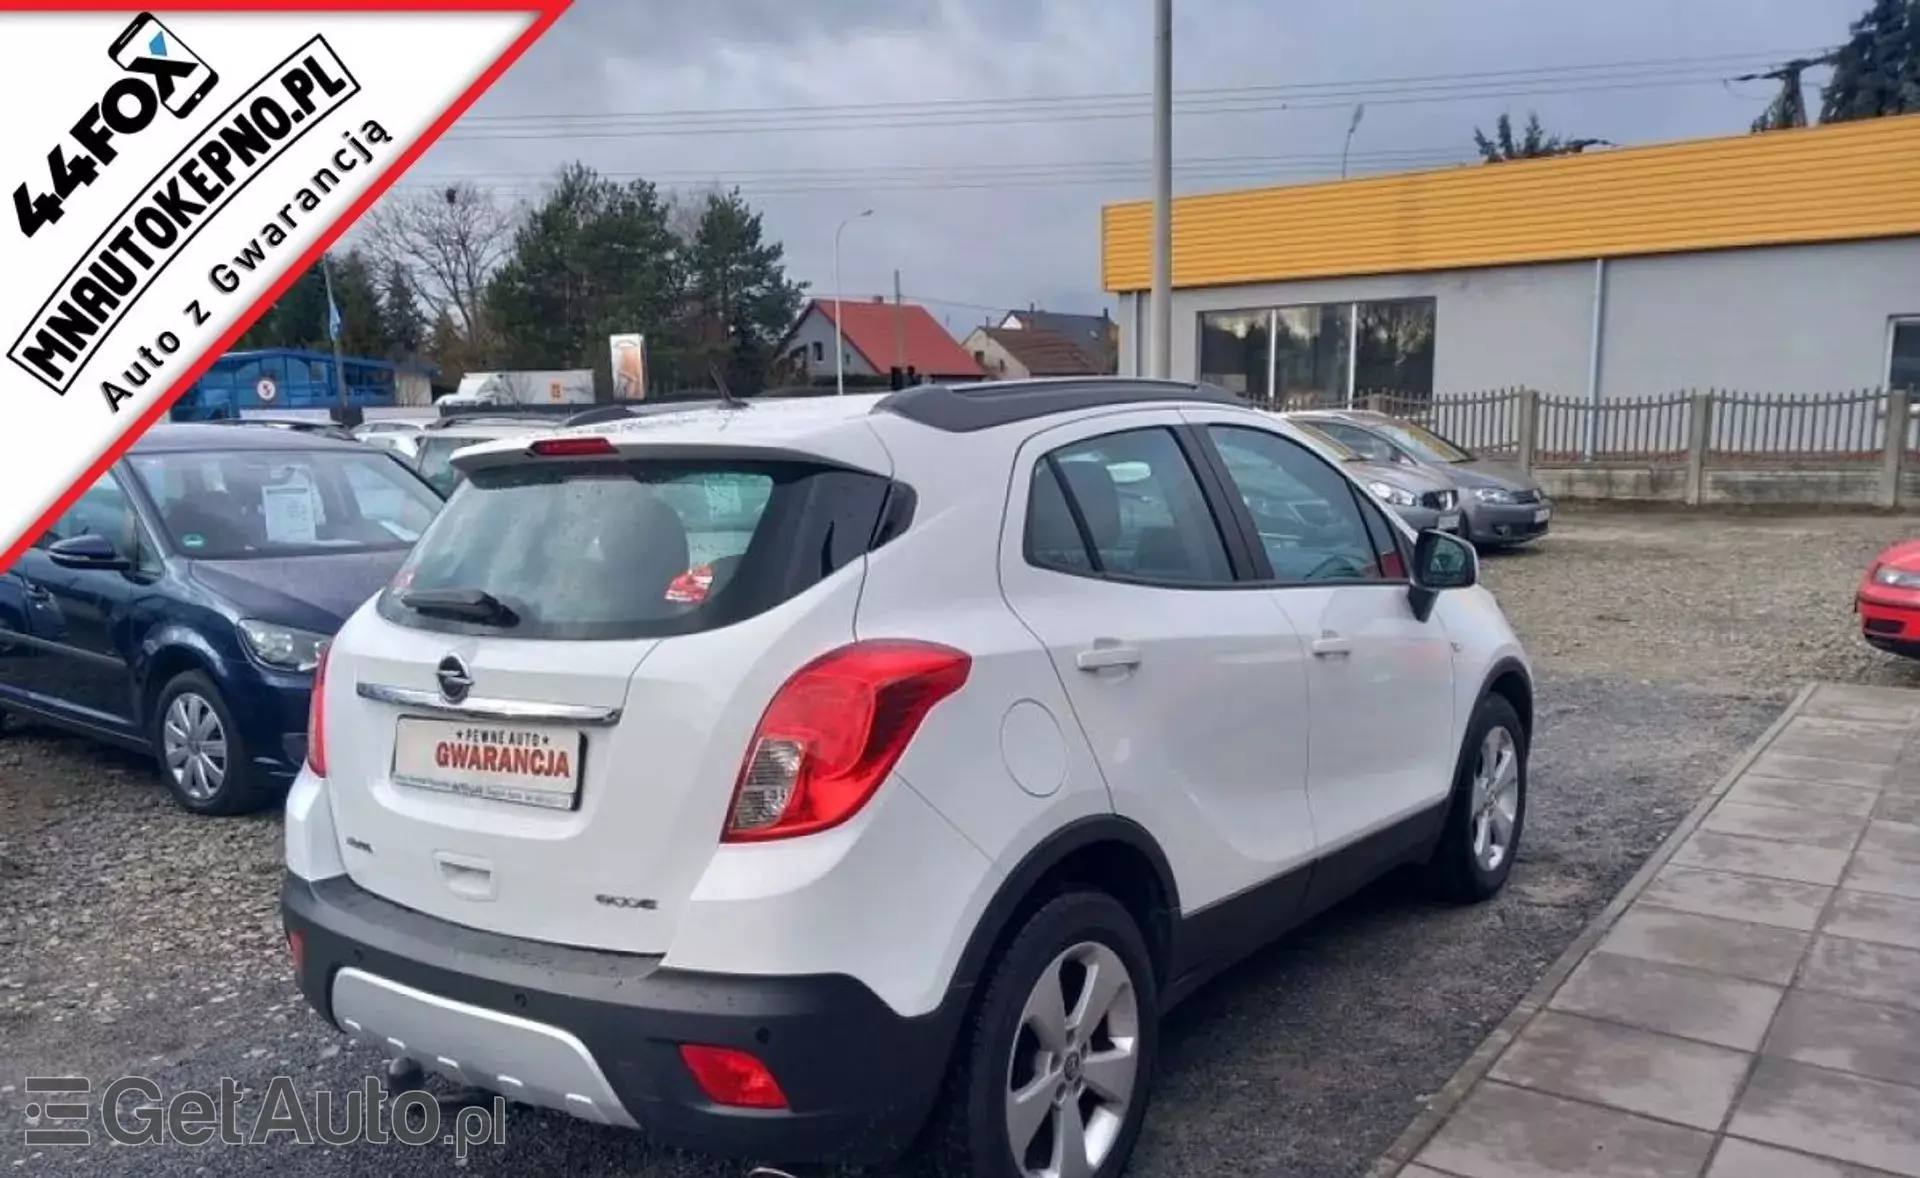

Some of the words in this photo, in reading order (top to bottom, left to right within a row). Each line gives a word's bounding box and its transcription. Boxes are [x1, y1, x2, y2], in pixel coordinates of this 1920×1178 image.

[466, 728, 504, 745] PEWNE
[508, 732, 539, 747] AUTO
[436, 741, 571, 778] GWARANCJA
